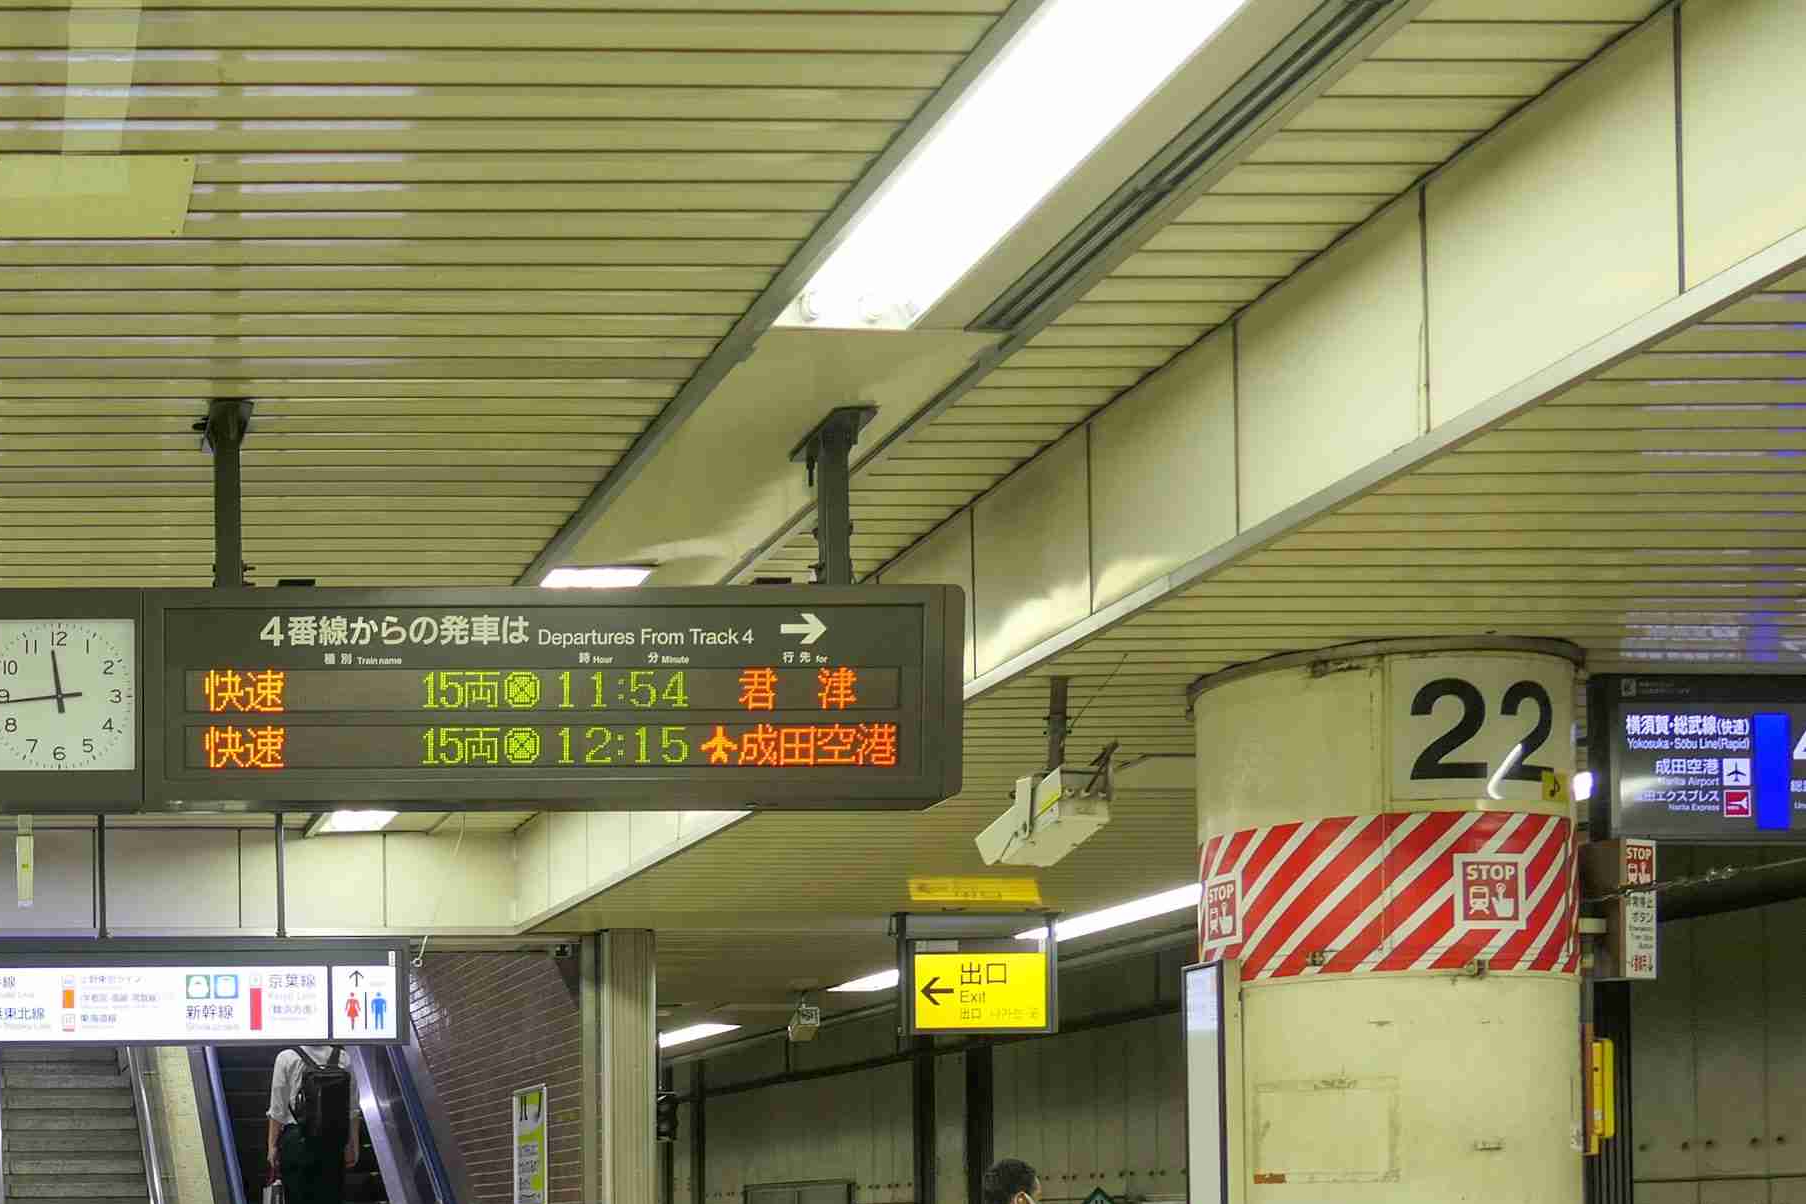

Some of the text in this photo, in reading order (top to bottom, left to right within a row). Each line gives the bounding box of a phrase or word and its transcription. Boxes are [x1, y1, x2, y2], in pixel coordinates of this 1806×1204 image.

[259, 615, 754, 648] 4番線からの発車は Departures From Track 4
[51, 632, 67, 646] 12
[26, 640, 37, 654] 11
[86, 640, 90, 654] 1
[356, 656, 378, 665] Train
[593, 656, 612, 664] Hour
[647, 652, 689, 664] 分 Minute
[816, 655, 828, 664] for
[3, 660, 18, 675] 10
[103, 660, 115, 675] 2
[110, 689, 122, 703] 3
[204, 669, 285, 712] 快速
[422, 671, 501, 709] 15両
[559, 671, 690, 708] 11:54
[5, 718, 17, 732] 8
[103, 718, 114, 732] 4
[1409, 677, 1555, 783] 22
[26, 739, 38, 753] 7
[83, 739, 94, 753] 5
[204, 723, 897, 768] 快速 15両 12:15 成田空港
[53, 746, 66, 760] 6
[1655, 758, 1719, 775] 成田空港
[1688, 777, 1719, 788] Airport
[1626, 847, 1652, 860] STOP
[1467, 864, 1515, 880] STOP
[960, 961, 1006, 985] 出口
[960, 991, 985, 1003] Exit
[186, 1004, 234, 1020] 新幹線
